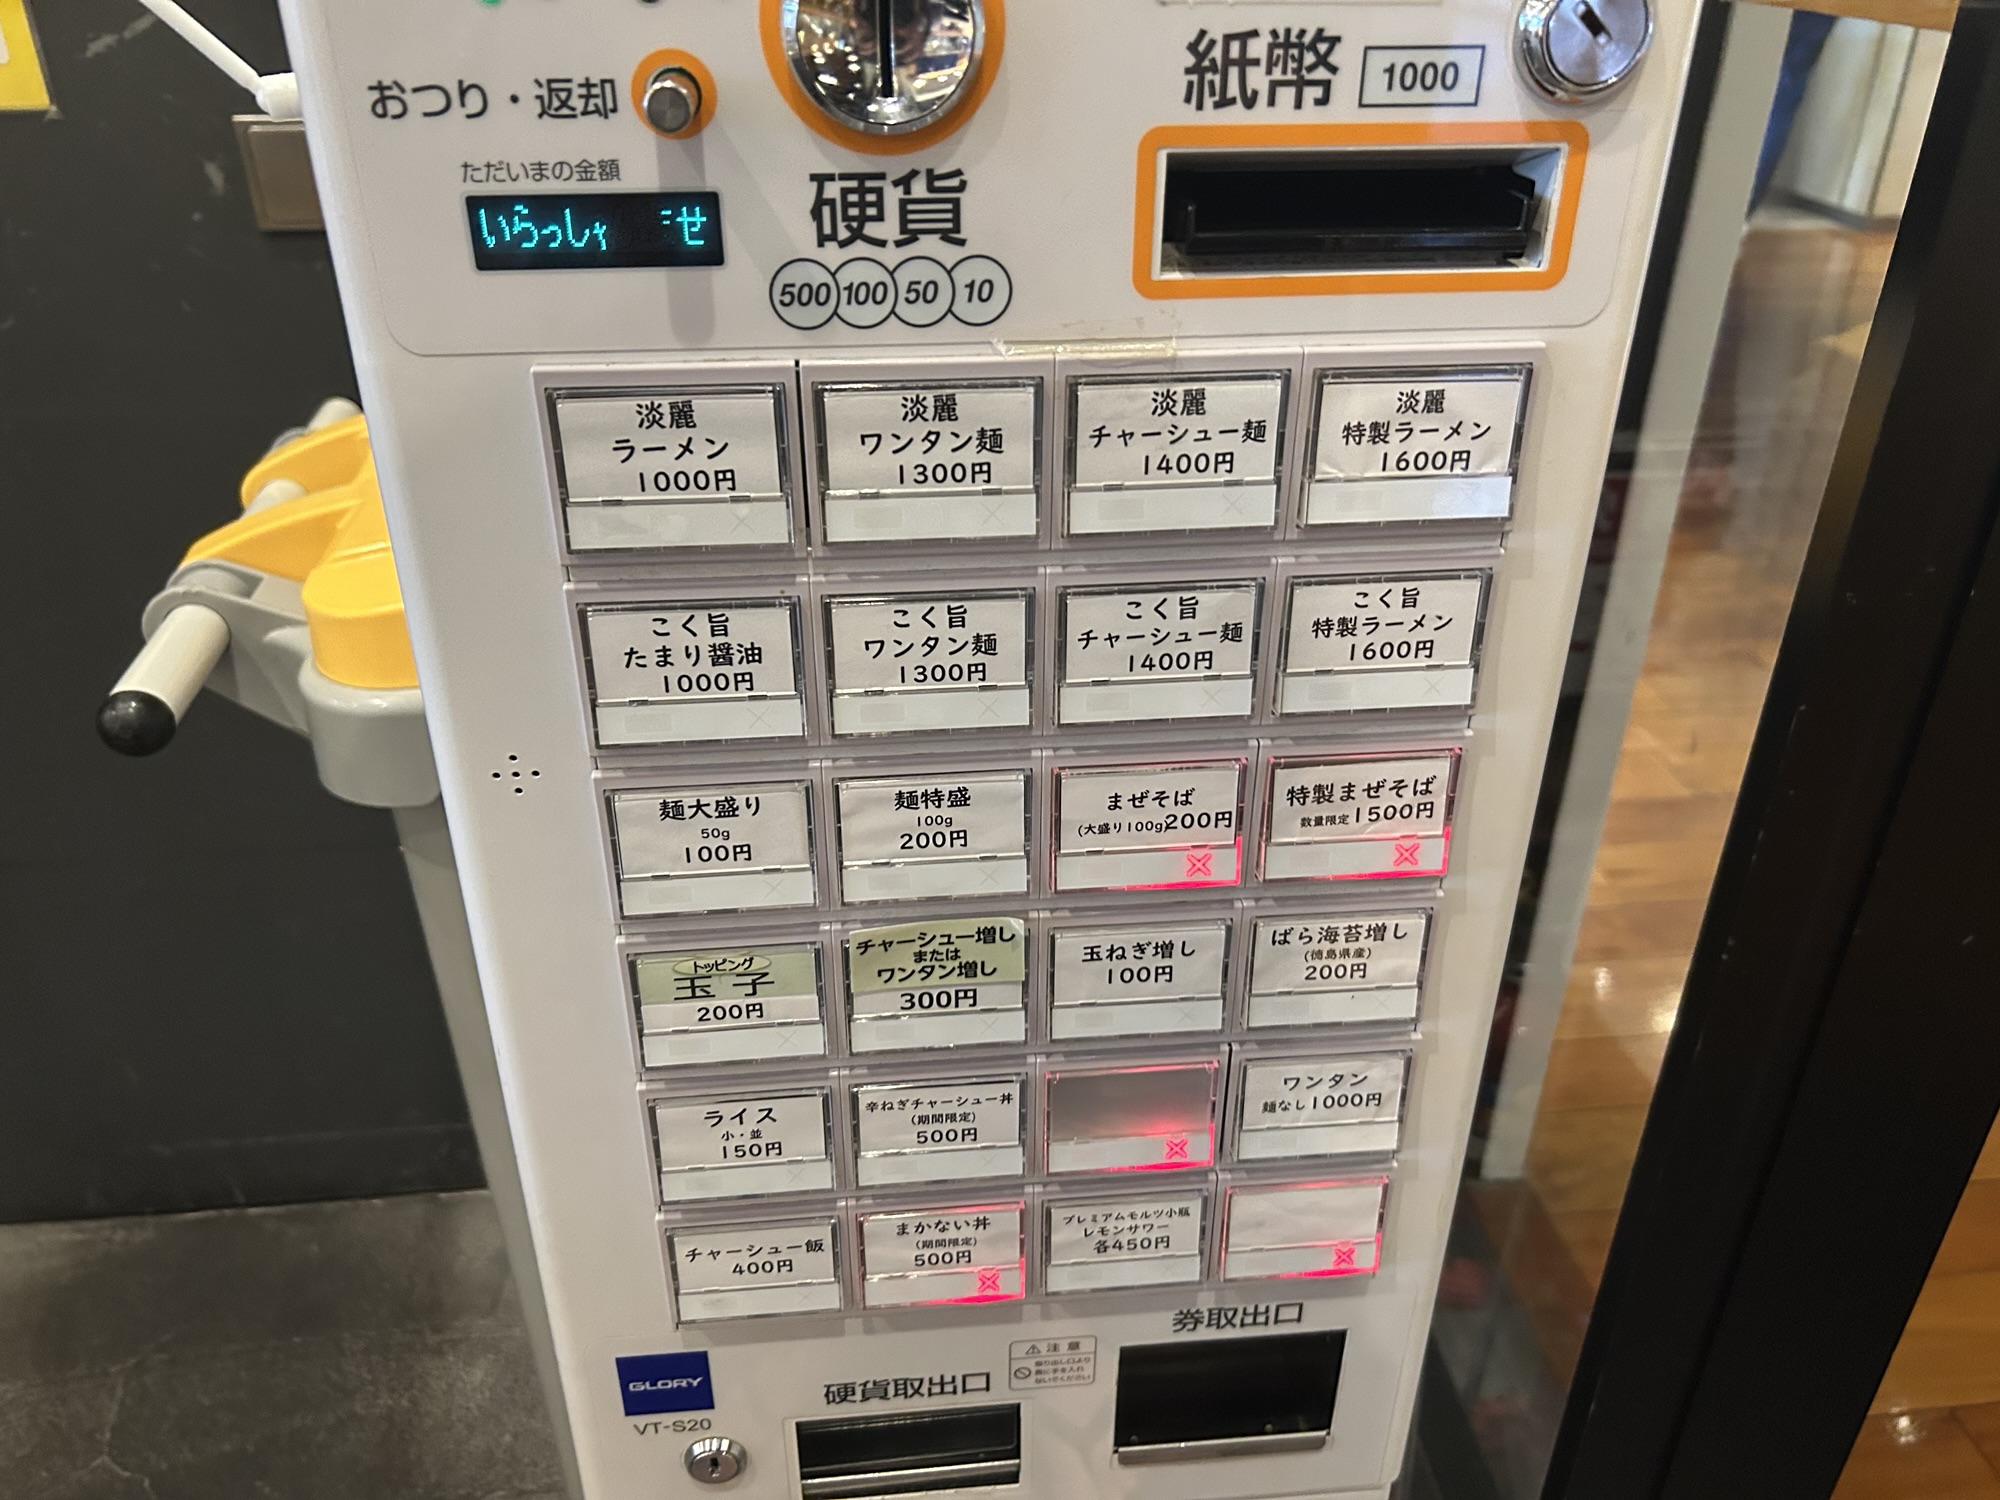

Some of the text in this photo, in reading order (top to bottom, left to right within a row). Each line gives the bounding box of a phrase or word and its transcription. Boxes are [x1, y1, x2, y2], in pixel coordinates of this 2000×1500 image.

[1183, 27, 1342, 111] 紙幣
[1383, 61, 1459, 92] 1000
[367, 76, 619, 120] おつり・返却
[461, 158, 621, 184] ただいまの金額
[809, 168, 968, 249] 硬貨
[779, 278, 995, 308] 500 100 50 10
[901, 393, 959, 423] 淡麗
[1151, 388, 1206, 417] 淡麗
[1395, 388, 1446, 415] 淡麗
[635, 399, 697, 430] 淡麗
[860, 426, 1004, 456] ワンタン麺
[1088, 418, 1267, 449] チャーシュー麺
[1341, 420, 1492, 446] 特製ラーメン
[612, 436, 729, 464] ラーメン
[1381, 449, 1471, 473] 1600円
[899, 461, 992, 485] 1300円
[1144, 451, 1235, 476] 1400円
[639, 468, 737, 493] 1000円
[1126, 595, 1199, 621] こく旨
[1354, 587, 1420, 609] こく旨
[651, 612, 730, 638] こく旨
[893, 604, 968, 630] こく旨
[1311, 613, 1453, 642] 特製ラーメン
[864, 632, 999, 660] ワンタン麺
[1077, 621, 1243, 650] チャーシュー麺
[623, 641, 763, 669] たまり醤油
[1129, 650, 1213, 673] 1400円
[1349, 639, 1435, 662] 1600円
[663, 671, 755, 694] 1000円
[900, 662, 989, 686] 1300円
[894, 786, 972, 812] 麺特盛
[1107, 787, 1196, 811] まぜそば
[1286, 774, 1437, 808] 特製まぜそば
[658, 795, 760, 822] 麺大盛り
[1355, 800, 1435, 824] 1500円
[917, 814, 953, 828] 100g
[700, 827, 730, 841] 50g
[900, 829, 968, 850] 200円
[685, 843, 752, 864] 100円
[855, 925, 1016, 957] チャーシュー増し
[1271, 922, 1408, 949] ばら海苔増し
[913, 946, 962, 964] または
[1081, 939, 1196, 963] 玉ねぎ増し
[693, 956, 755, 974] トッピング
[877, 961, 998, 983] ワンタン増し
[1108, 964, 1174, 985] 100円
[1304, 962, 1367, 981] 200円
[673, 970, 775, 1001] 玉子
[900, 988, 978, 1011] 300円
[697, 1002, 764, 1023] 200円
[1283, 1073, 1368, 1092] ワンタン
[865, 1092, 1014, 1114] 辛ねぎチャーシュー丼
[703, 1107, 777, 1127] ライス
[911, 1111, 976, 1126] (期間限定)
[916, 1127, 978, 1145] 500円
[722, 1140, 783, 1159] 150円
[896, 1215, 991, 1237] まかない丼
[1083, 1222, 1170, 1238] レモンサワー
[685, 1238, 825, 1264] チャーシュー飯
[1093, 1234, 1170, 1255] 各450円
[732, 1258, 793, 1276] 400円
[914, 1248, 972, 1267] 500円
[1172, 1302, 1304, 1334] 券取出口
[628, 1376, 704, 1392] GLORY
[823, 1371, 993, 1406] 硬貨取出口
[633, 1418, 712, 1436] VT-S20
